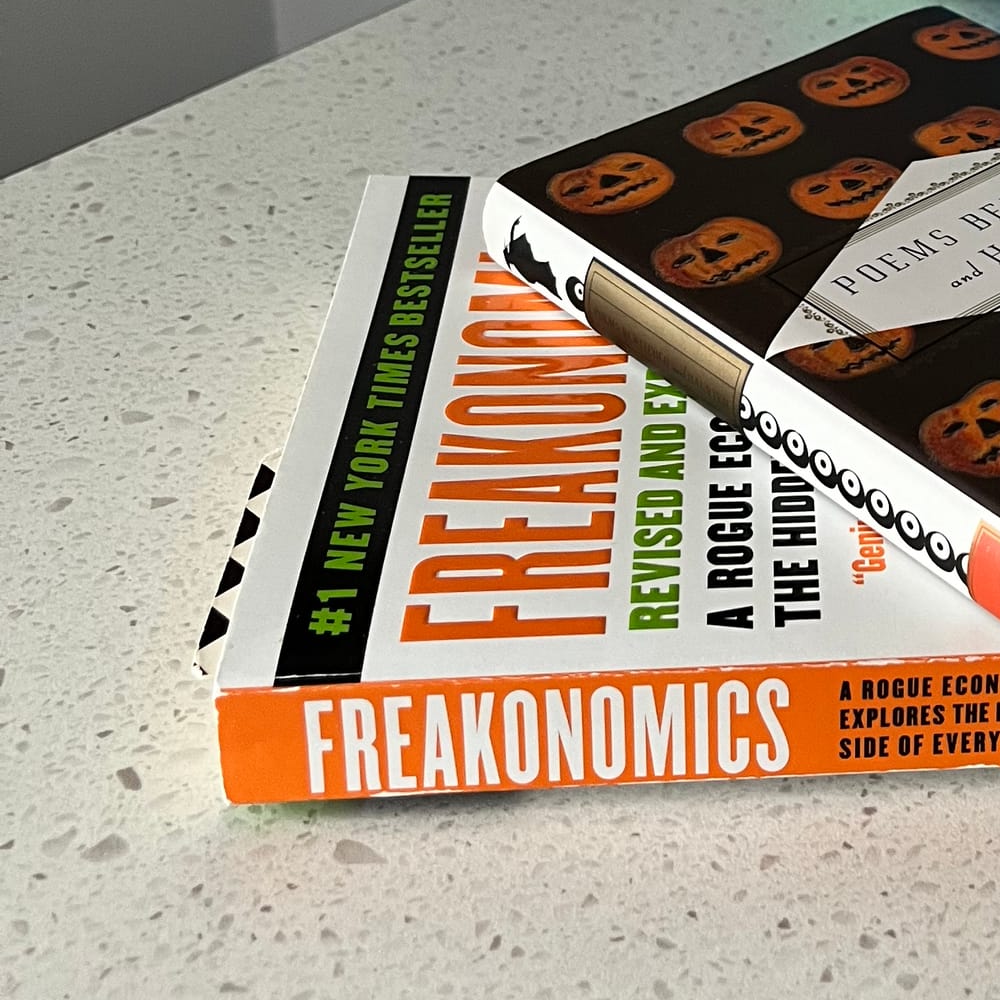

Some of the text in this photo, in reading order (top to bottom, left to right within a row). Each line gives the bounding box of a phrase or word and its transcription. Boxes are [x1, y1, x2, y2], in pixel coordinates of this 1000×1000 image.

[831, 228, 959, 296] POEMS
[951, 260, 984, 288] and
[308, 194, 452, 636] #1 NEW YORK TIMES BESTSELLER
[639, 423, 686, 480] AND
[628, 489, 683, 630] REVISED
[706, 483, 754, 588] ROGUE
[706, 605, 754, 630] A
[773, 559, 822, 628] THE
[839, 680, 852, 701] A
[862, 676, 933, 699] ROGUE
[839, 703, 945, 729] EXPLORES
[953, 702, 989, 724] THE
[303, 677, 791, 794] FREAKONOMICS
[838, 735, 890, 760] SIDE
[899, 732, 924, 756] OF
